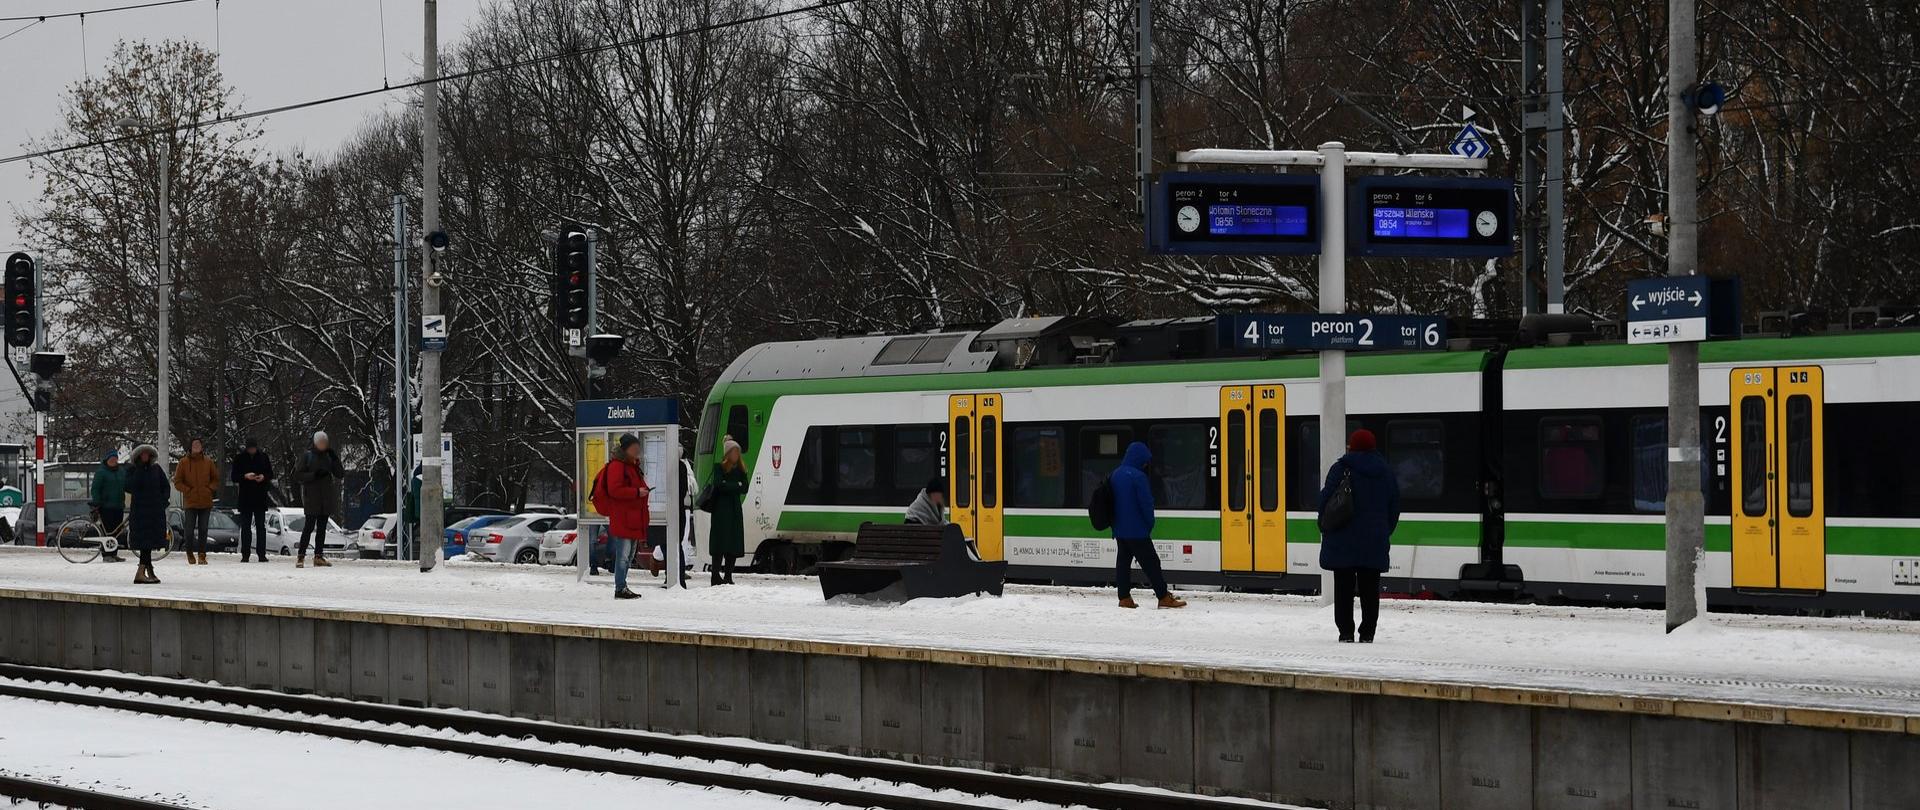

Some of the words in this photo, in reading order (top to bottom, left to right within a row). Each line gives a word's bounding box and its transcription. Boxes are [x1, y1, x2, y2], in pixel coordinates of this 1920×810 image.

[1648, 287, 1685, 306] wyjście
[1243, 321, 1260, 344] 4
[1268, 324, 1284, 335] tor
[1311, 320, 1354, 336] peron
[1358, 318, 1374, 345] 2
[1331, 336, 1354, 345] platform
[1401, 325, 1416, 336] tor
[1424, 323, 1440, 346] 6
[607, 405, 635, 419] Zielonka
[1209, 426, 1217, 449] 2
[1715, 416, 1726, 443] 2
[940, 431, 946, 452] 2
